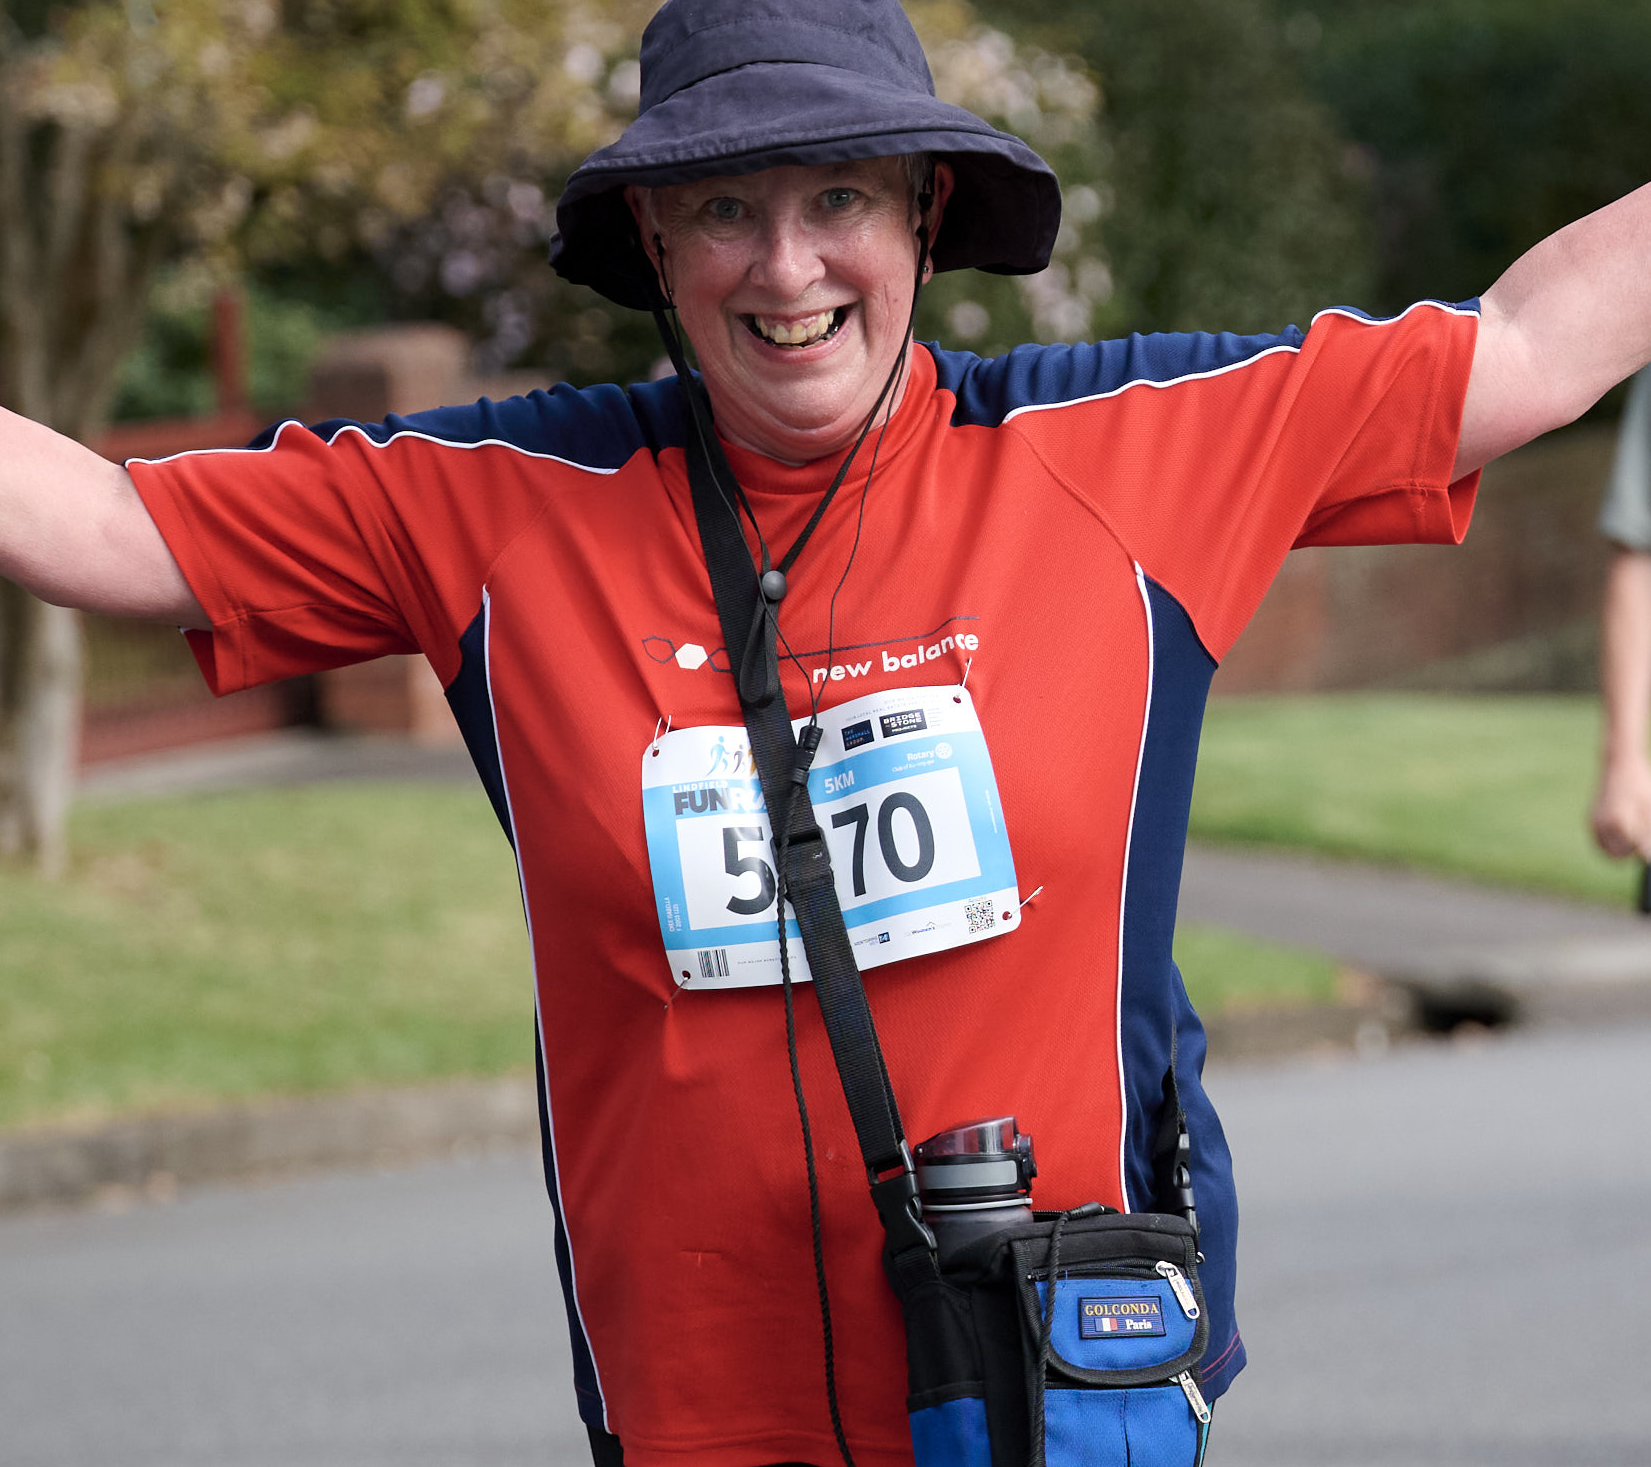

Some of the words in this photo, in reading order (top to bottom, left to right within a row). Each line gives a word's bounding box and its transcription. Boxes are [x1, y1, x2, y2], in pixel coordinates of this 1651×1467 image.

[812, 660, 872, 684] new
[881, 633, 979, 672] balance
[883, 712, 922, 724] BRIDGE
[906, 747, 935, 762] Rotary
[672, 780, 729, 793] LINDFIELD
[824, 770, 855, 795] 5KM
[673, 787, 766, 815] FUNRU
[722, 792, 936, 915] 570
[1084, 1303, 1159, 1316] GOLCONDA
[1125, 1318, 1152, 1330] Paris
